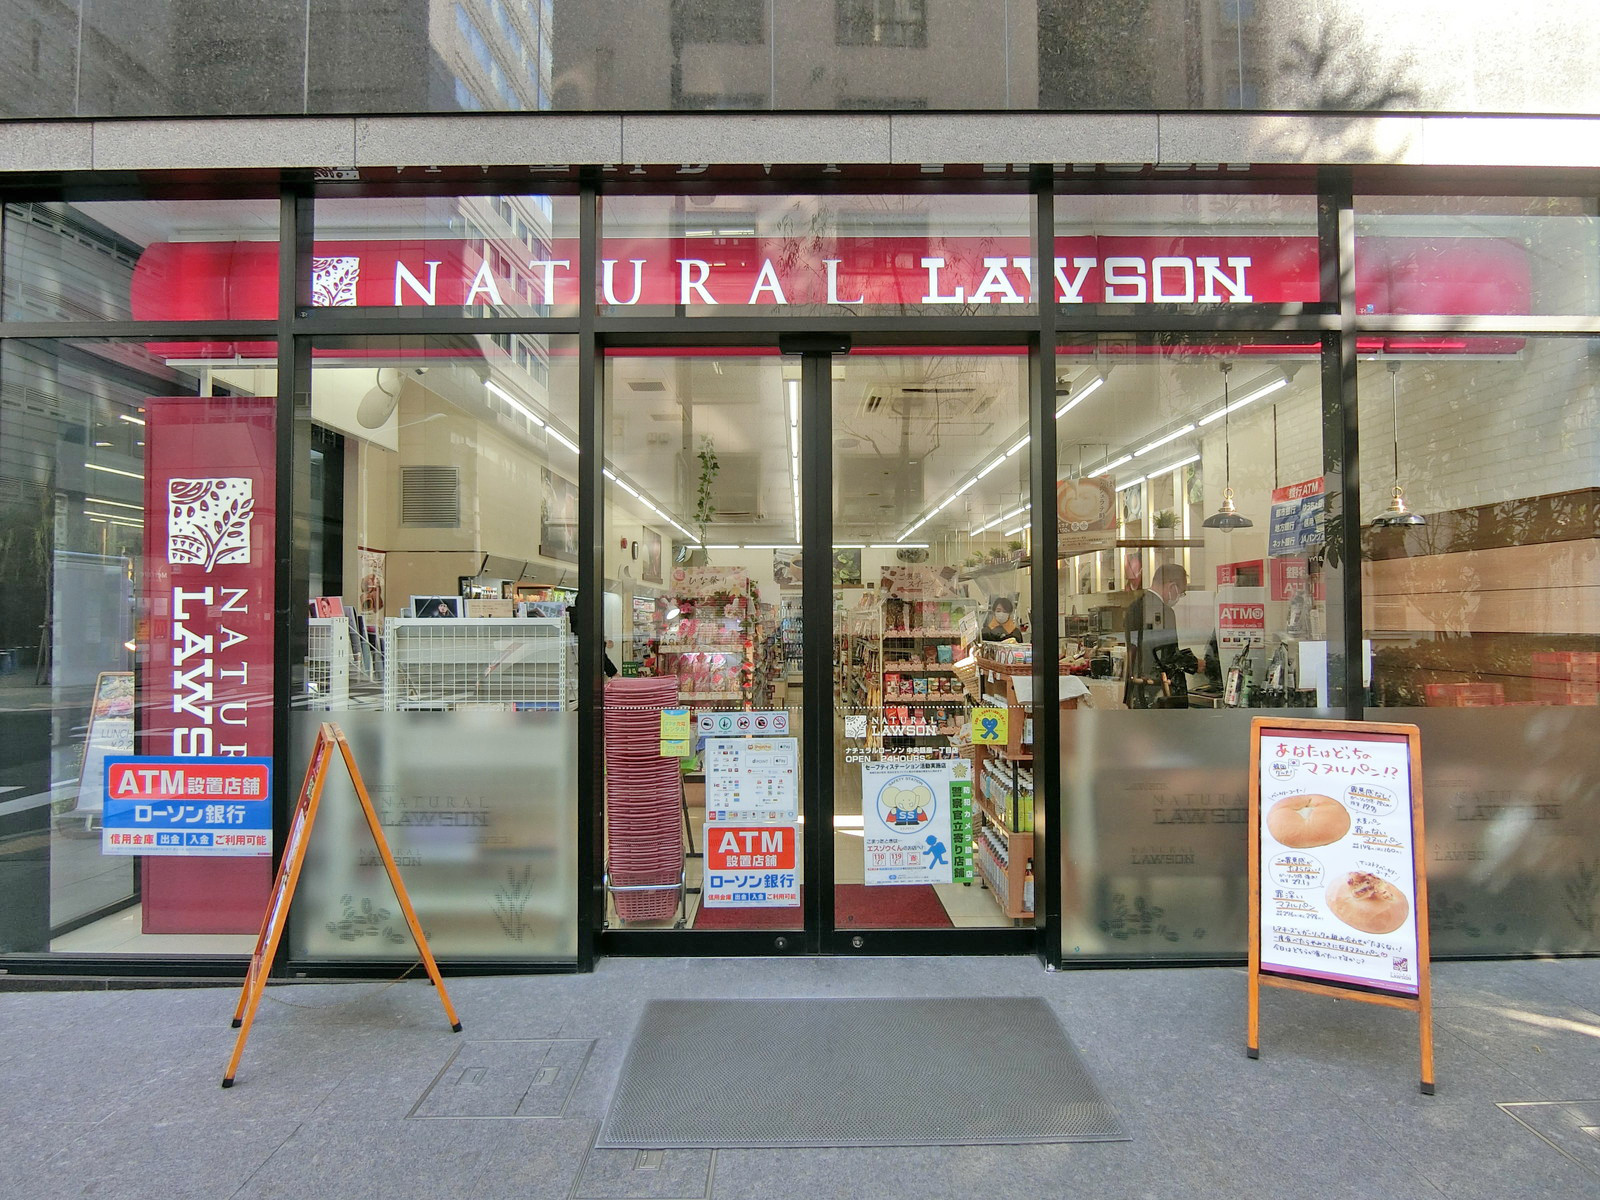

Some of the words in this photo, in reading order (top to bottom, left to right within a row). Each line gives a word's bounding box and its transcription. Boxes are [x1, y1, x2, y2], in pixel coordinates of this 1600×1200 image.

[394, 258, 865, 307] NATURAL
[920, 256, 1253, 305] LAWSON
[1288, 481, 1318, 499] 銀行ATM
[1221, 607, 1252, 620] ATM
[871, 716, 938, 725] NATURAL
[871, 725, 938, 737] LAWSON
[845, 746, 905, 754] ナチュラルローソン
[1275, 743, 1372, 759] あなたはどっちの
[845, 755, 871, 763] OPEN
[880, 755, 926, 763] 24HOURS
[381, 796, 489, 809] NATURAL
[134, 804, 246, 824] ローソン銀行
[381, 811, 491, 827] LAWSON
[899, 811, 915, 820] SS
[110, 833, 154, 845] 信用金庫
[160, 834, 180, 845] 出金
[190, 834, 209, 845] 入金
[215, 834, 267, 846] ご利用可能
[718, 831, 783, 853] ATM
[359, 848, 422, 856] NARAL
[726, 855, 777, 867] 設置店舗
[710, 874, 795, 889] ローソン銀行
